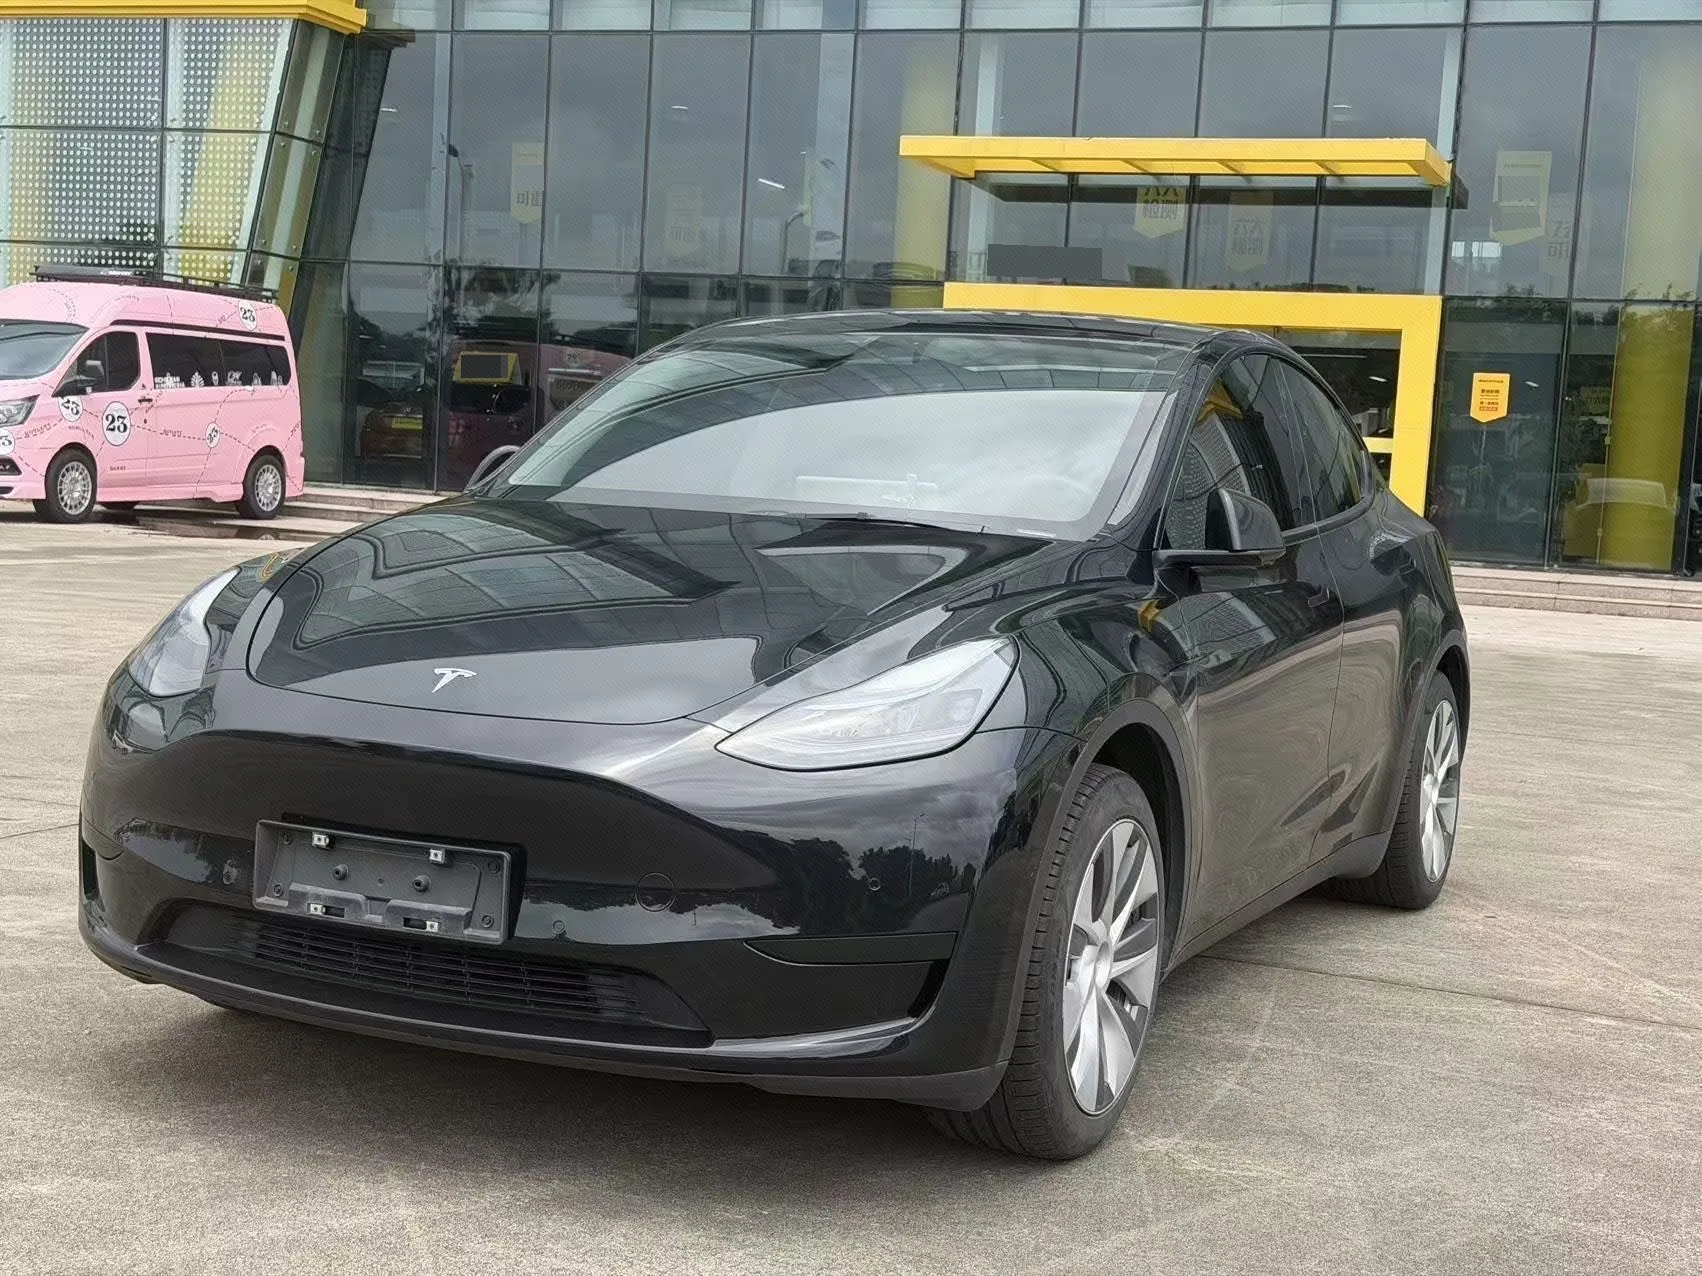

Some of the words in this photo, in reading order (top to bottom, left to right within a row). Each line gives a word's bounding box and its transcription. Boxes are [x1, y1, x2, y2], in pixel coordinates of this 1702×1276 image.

[240, 306, 256, 322] 23
[61, 399, 80, 416] 23
[105, 413, 128, 434] 23
